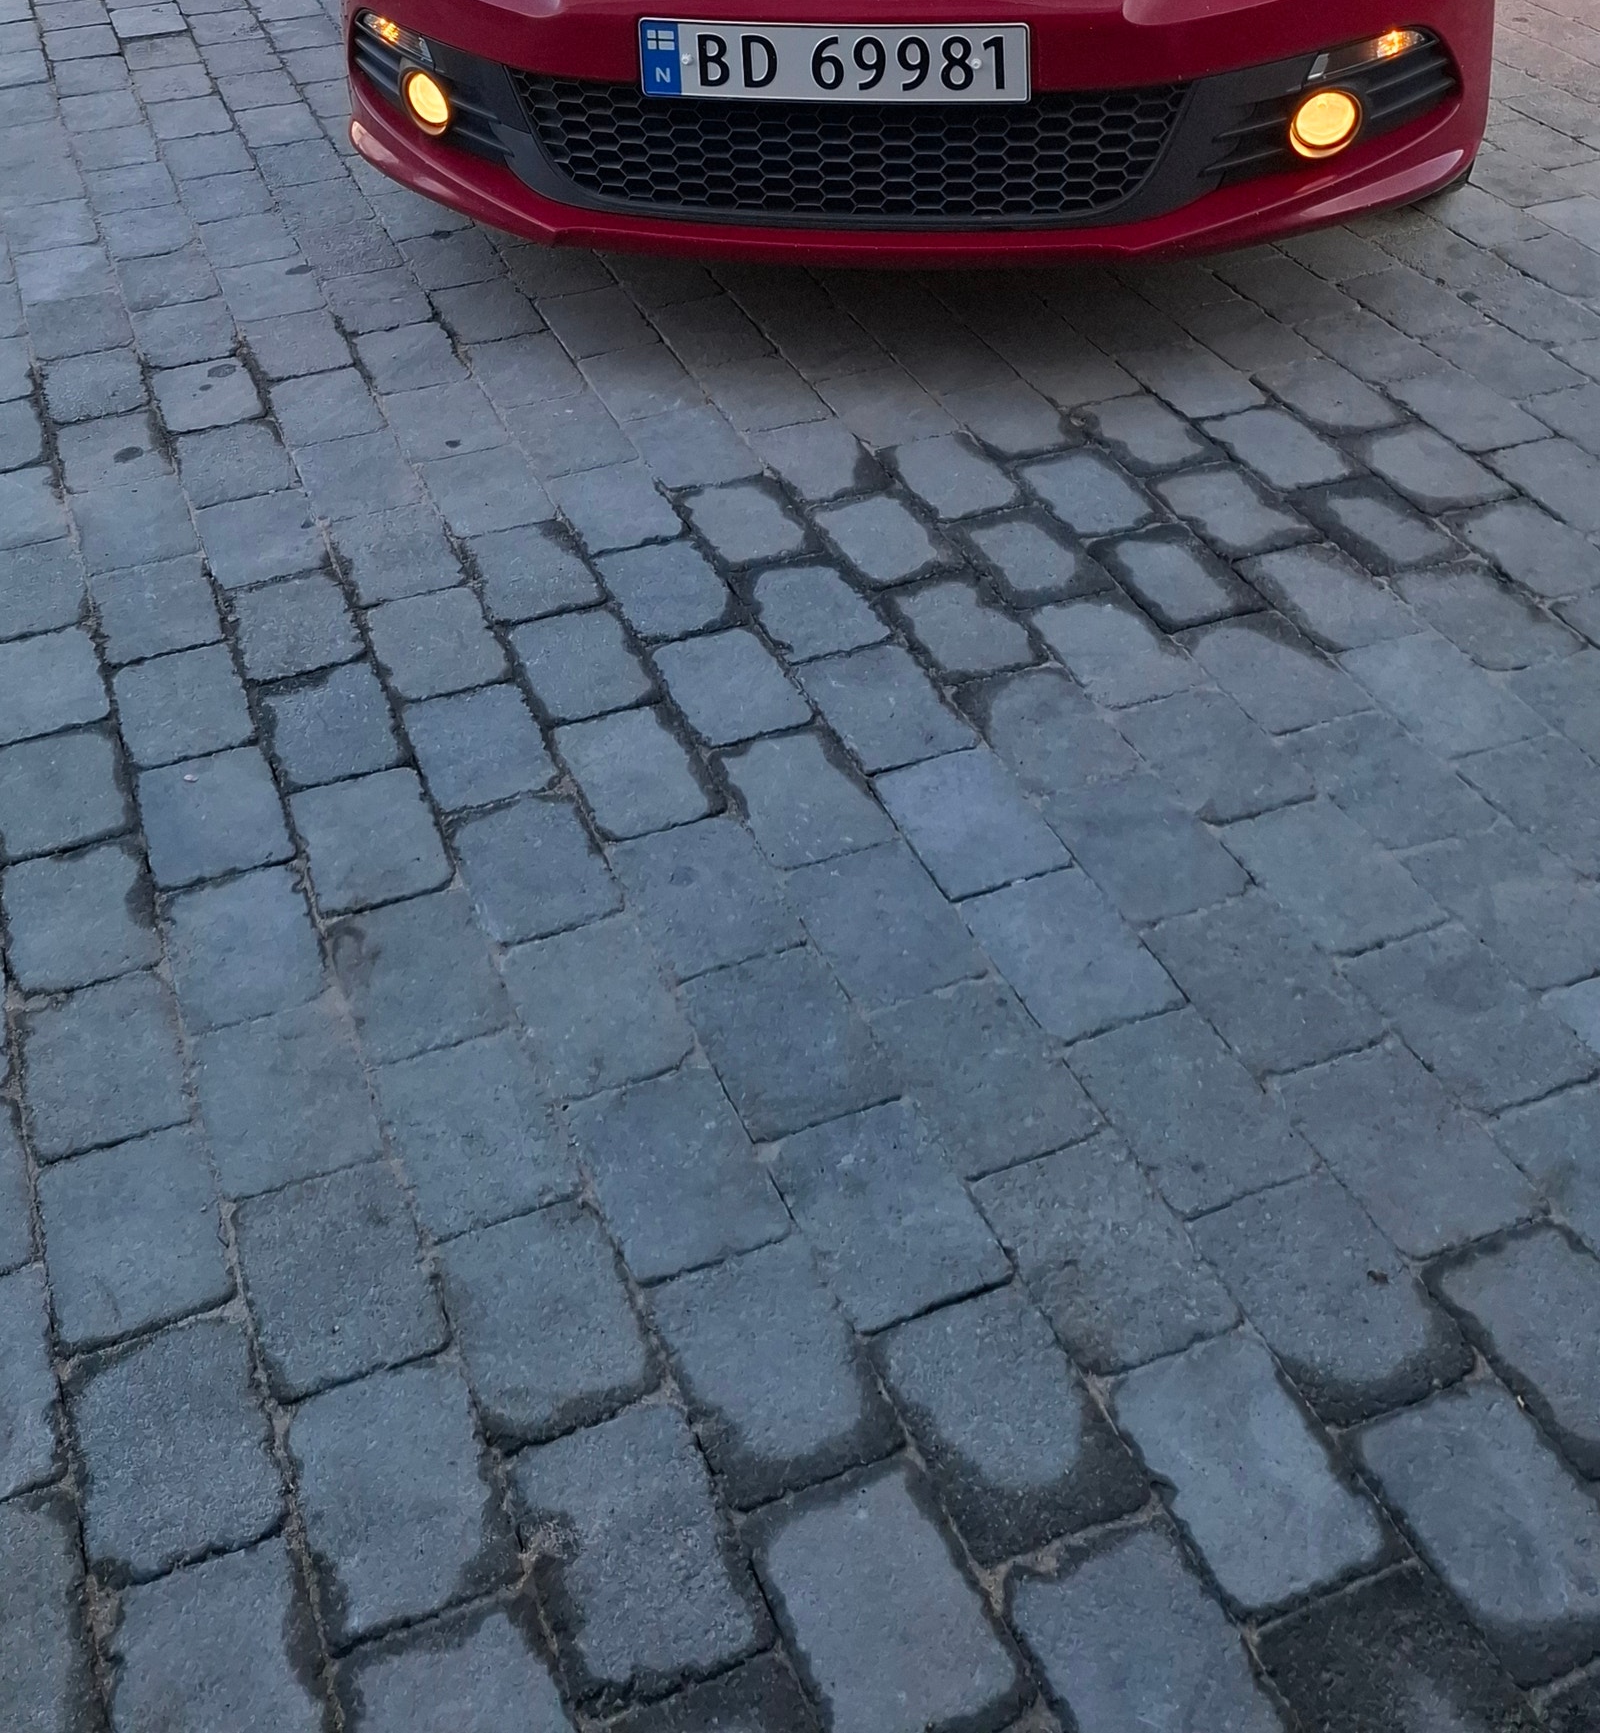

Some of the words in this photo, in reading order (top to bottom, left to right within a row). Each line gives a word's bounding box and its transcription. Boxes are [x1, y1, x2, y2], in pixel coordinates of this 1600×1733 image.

[655, 67, 671, 83] N
[697, 33, 778, 88] BD
[811, 35, 1005, 91] 69981
